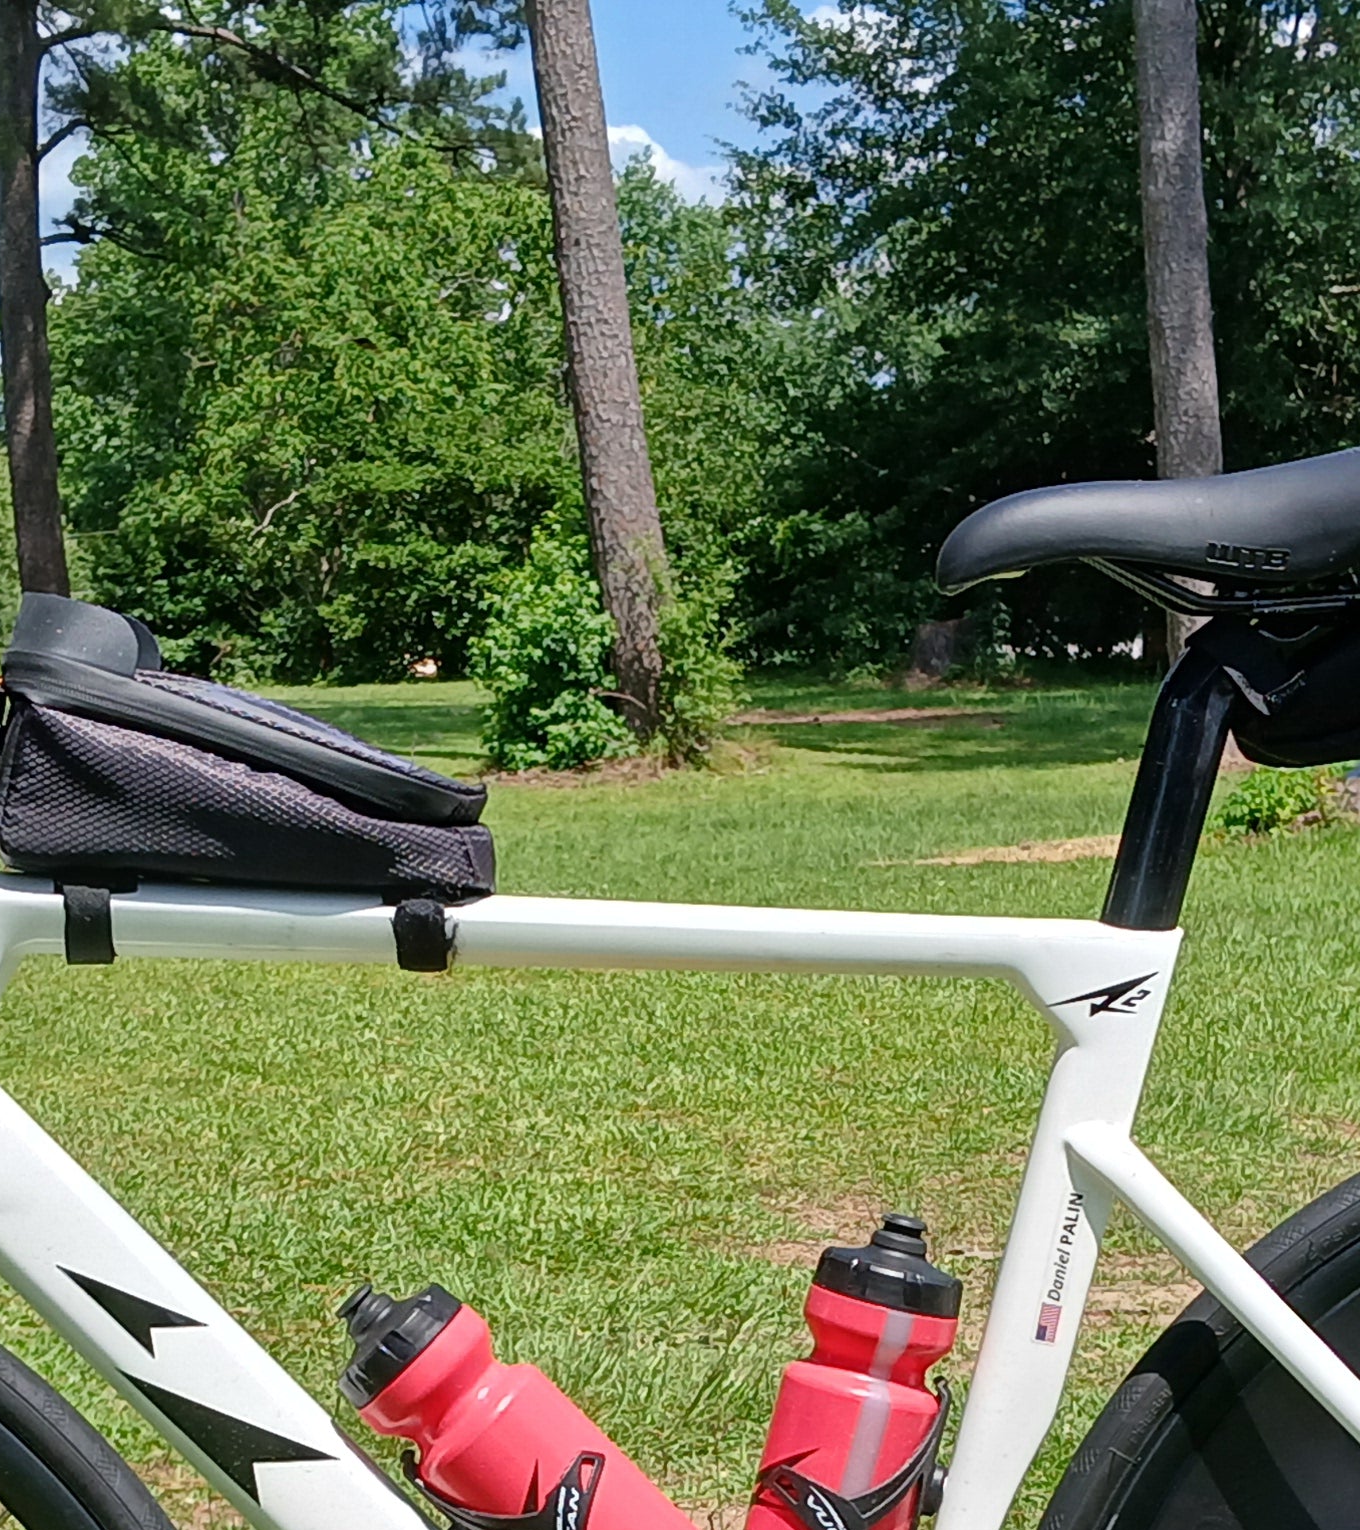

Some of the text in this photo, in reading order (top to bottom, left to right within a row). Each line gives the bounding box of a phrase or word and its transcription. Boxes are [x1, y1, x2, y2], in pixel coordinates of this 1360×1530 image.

[1203, 540, 1292, 571] WTB
[1047, 1192, 1084, 1303] Daniel PALIN
